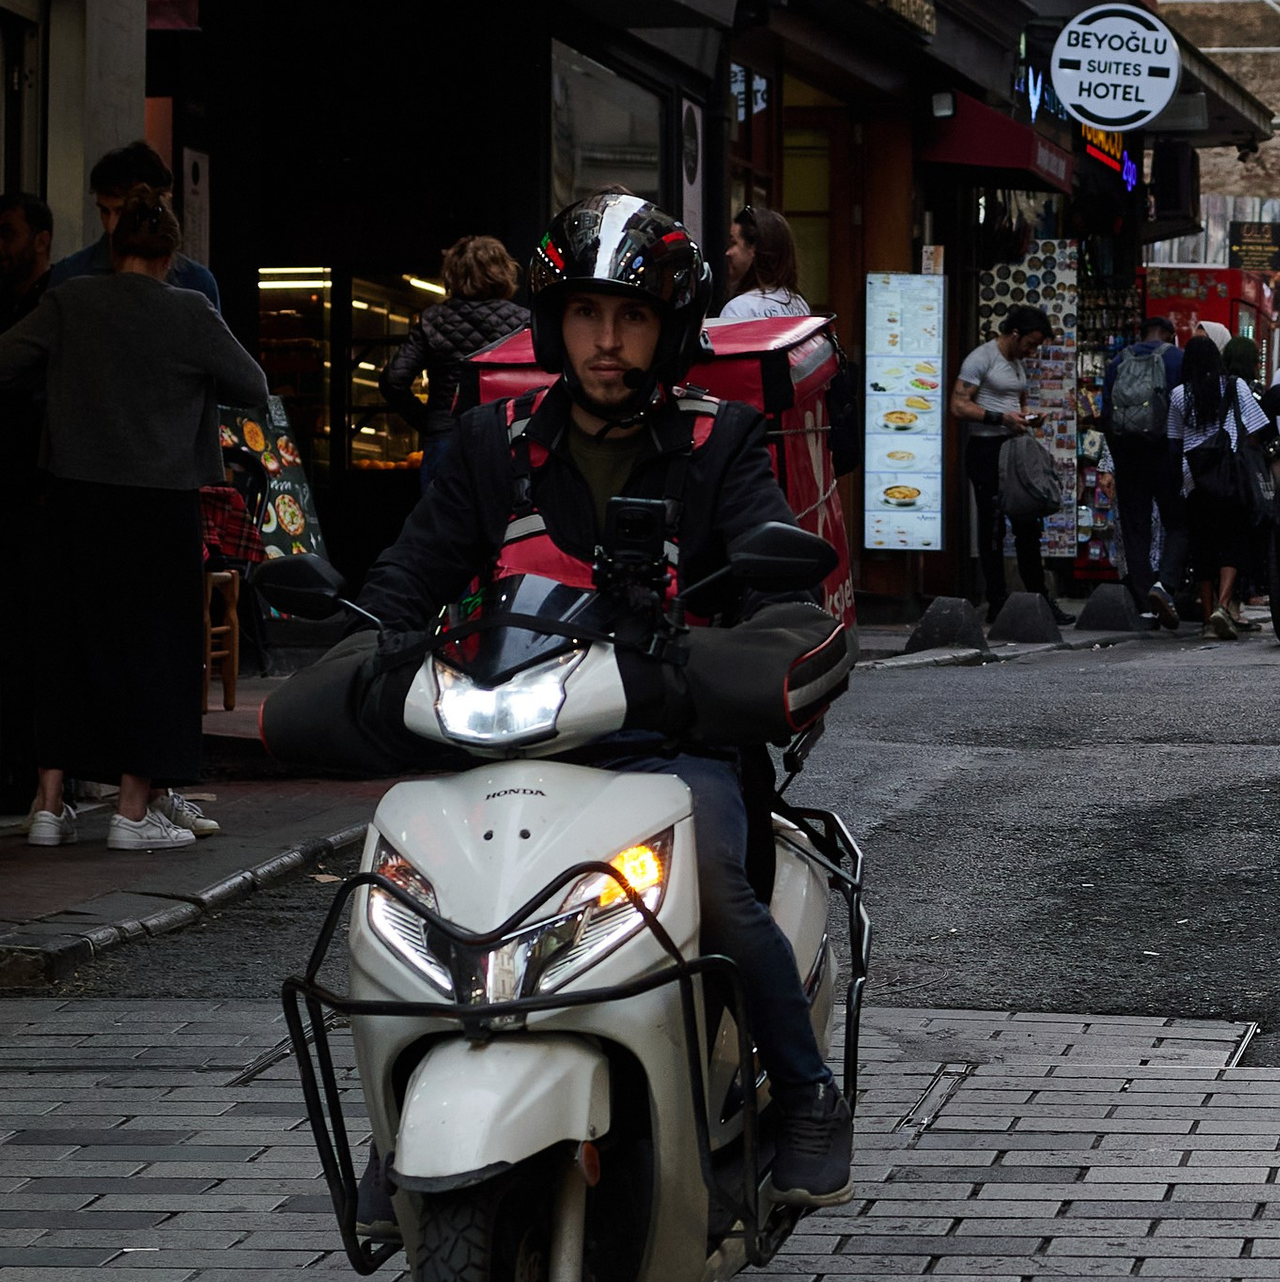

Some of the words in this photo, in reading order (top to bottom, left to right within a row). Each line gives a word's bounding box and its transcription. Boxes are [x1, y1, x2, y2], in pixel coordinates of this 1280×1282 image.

[1067, 30, 1167, 55] BEYOĞLU
[1087, 59, 1142, 77] SUITES
[1078, 81, 1145, 103] HOTEL
[484, 788, 548, 801] HONDA
